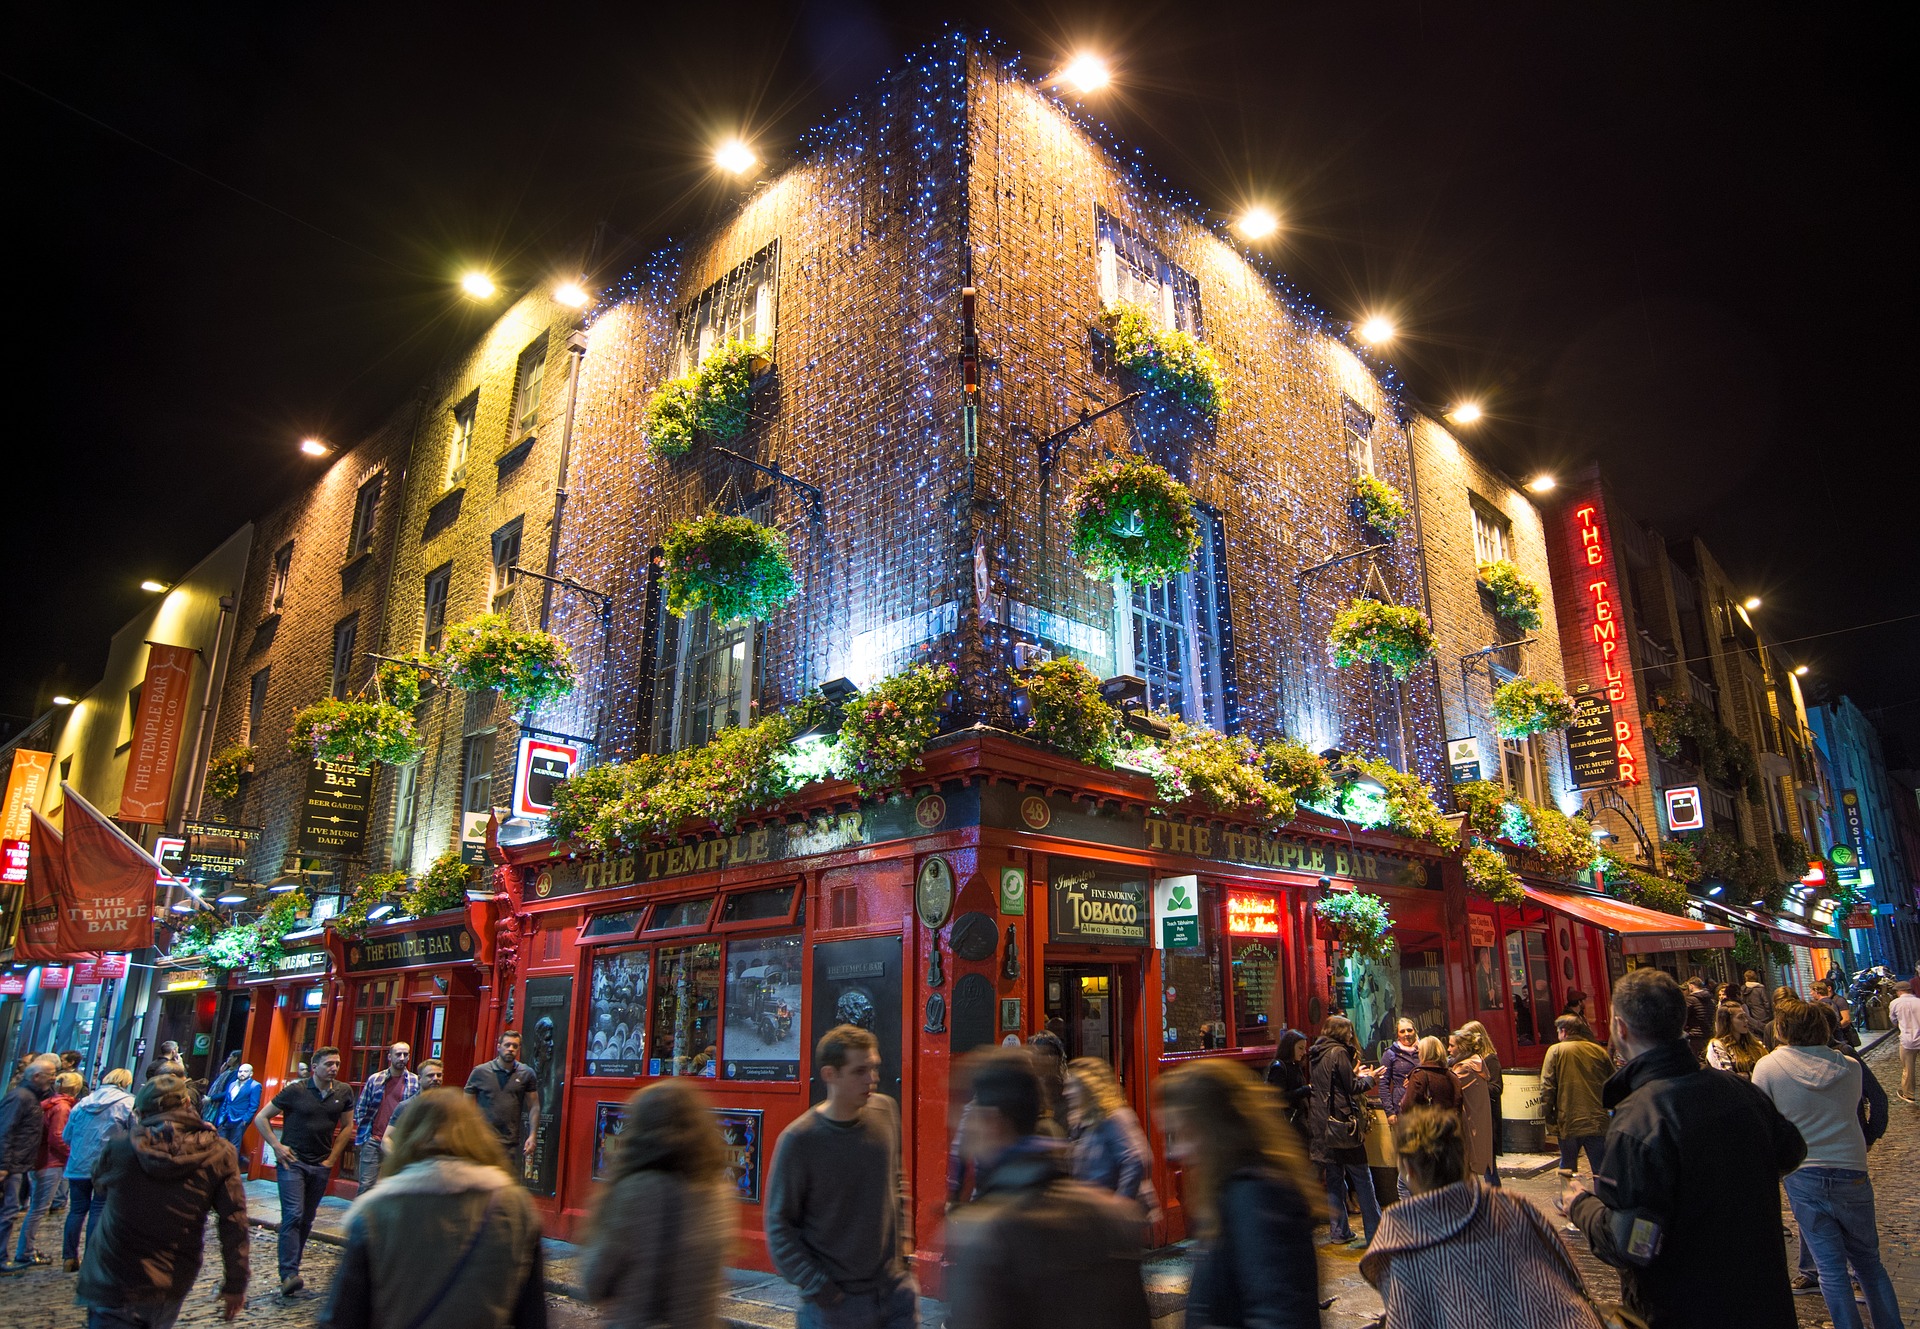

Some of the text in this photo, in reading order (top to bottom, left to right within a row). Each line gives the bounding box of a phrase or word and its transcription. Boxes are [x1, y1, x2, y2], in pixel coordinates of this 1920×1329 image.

[1040, 624, 1061, 640] LANE
[1577, 507, 1637, 783] THE TEMPLE BAR
[1576, 705, 1611, 719] EMPLE
[1577, 717, 1602, 728] BAR
[134, 676, 168, 793] THE TEMPLE BAR
[156, 698, 178, 774] TRADING CO.
[1570, 737, 1613, 749] BEER GARDEN
[313, 758, 371, 777] TEMPLE
[533, 767, 565, 778] GUINNESS
[1574, 759, 1614, 771] LIVE MUSIC
[1584, 767, 1606, 776] DAILY
[25, 773, 40, 795] THE
[324, 773, 356, 787] BAR
[5, 787, 22, 827] TRADING
[308, 799, 364, 811] BEER GARDEN
[921, 801, 940, 822] 48
[1025, 802, 1044, 821] 48
[186, 825, 260, 840] THE TEMPLE BAR
[307, 827, 359, 838] LIVE MUSIC
[1848, 808, 1865, 865] HOSTEL
[318, 837, 346, 845] DAILY
[582, 812, 864, 890] THE TEMPLE BAR
[1145, 818, 1379, 881] THE TEMPLE BAR
[190, 854, 248, 866] DISTILLERY
[202, 863, 235, 873] STORE
[538, 876, 550, 895] 48
[1055, 870, 1096, 892] Importers
[1091, 889, 1136, 901] FINE SMOKING
[92, 898, 126, 908] THE
[27, 912, 58, 924] TEMP
[67, 905, 148, 921] TEMPLE
[1066, 892, 1137, 930] TOBACCO
[87, 919, 129, 933] BAR
[1082, 924, 1143, 935] Always in Stock
[365, 935, 452, 962] THE TEMPLE BAR
[1240, 943, 1274, 961] TEMPLE BAR
[1424, 951, 1438, 968] THE
[828, 961, 883, 974] THE TEMPLE BAR
[1409, 970, 1440, 987] EMPEROR
[1525, 1096, 1542, 1109] JAM
